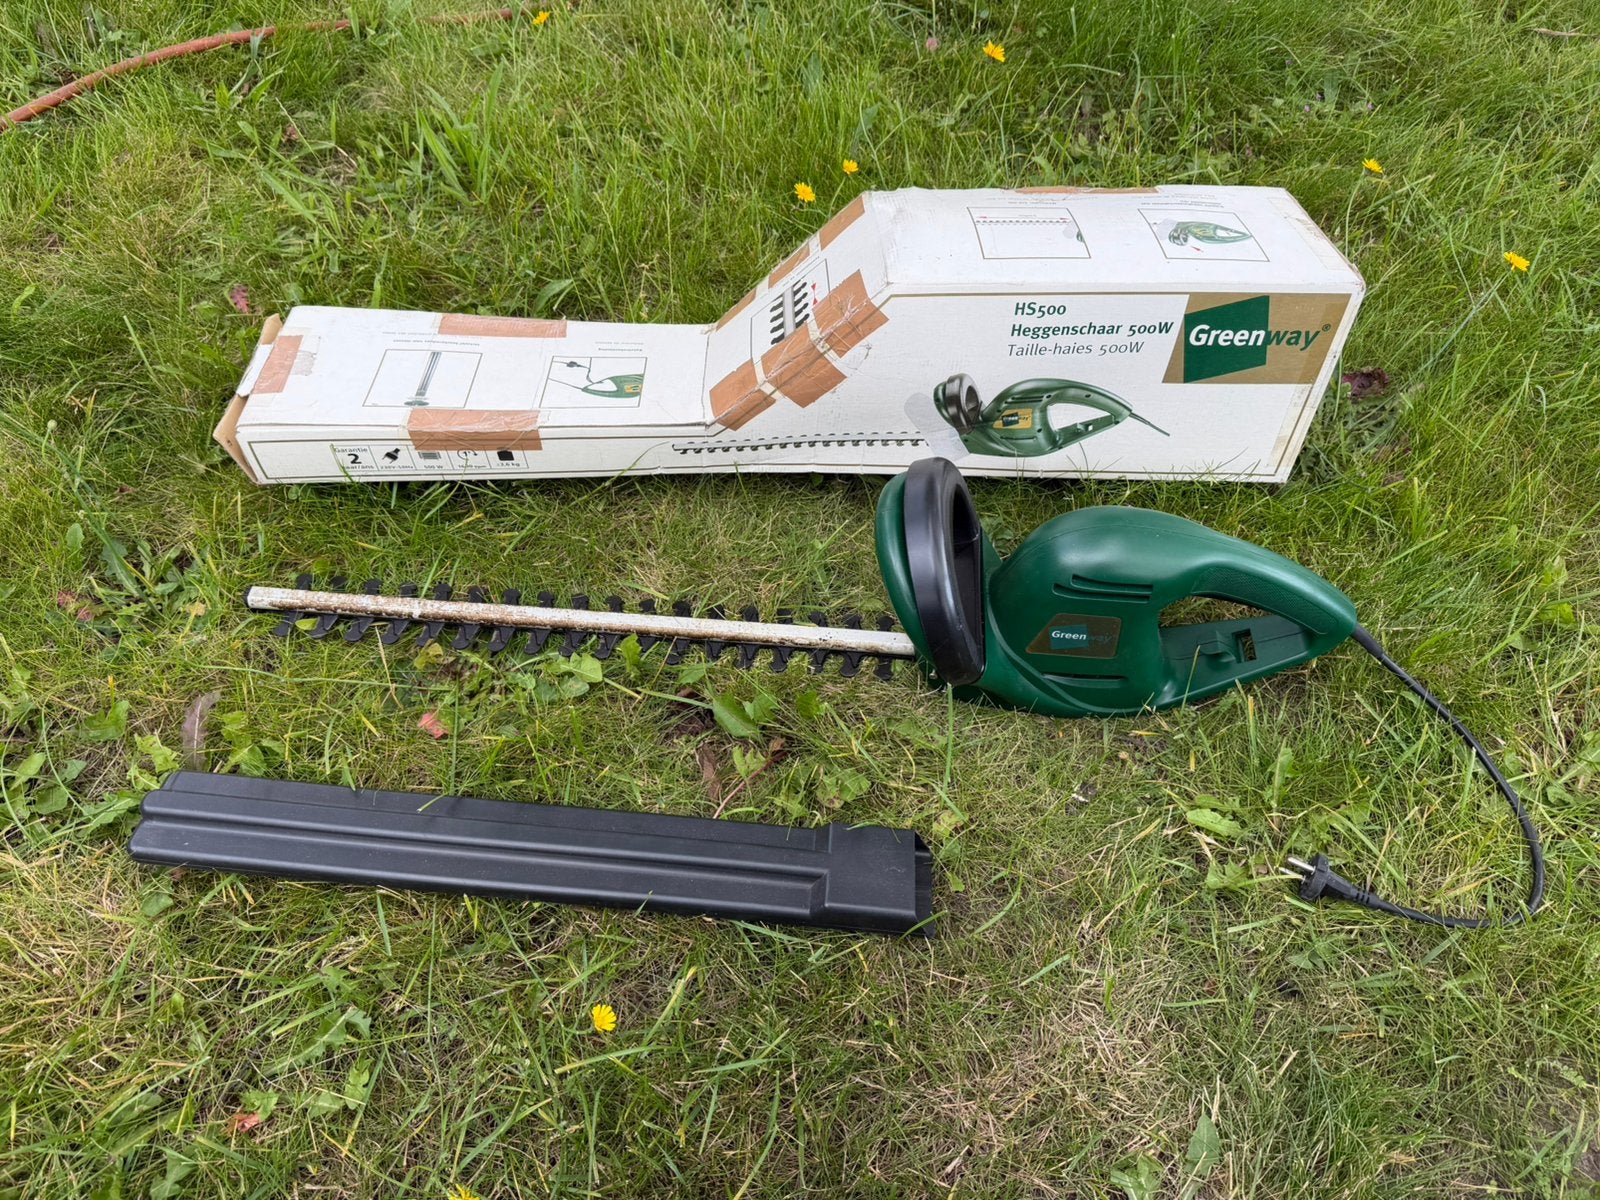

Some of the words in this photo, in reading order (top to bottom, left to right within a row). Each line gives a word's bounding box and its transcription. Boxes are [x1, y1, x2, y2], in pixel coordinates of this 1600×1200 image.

[1014, 302, 1067, 318] HS500
[1010, 322, 1121, 341] Heggenschaar
[1127, 321, 1174, 337] 500W
[1007, 342, 1093, 357] Taille-haies
[1099, 341, 1145, 357] 500W
[347, 453, 362, 464] 2
